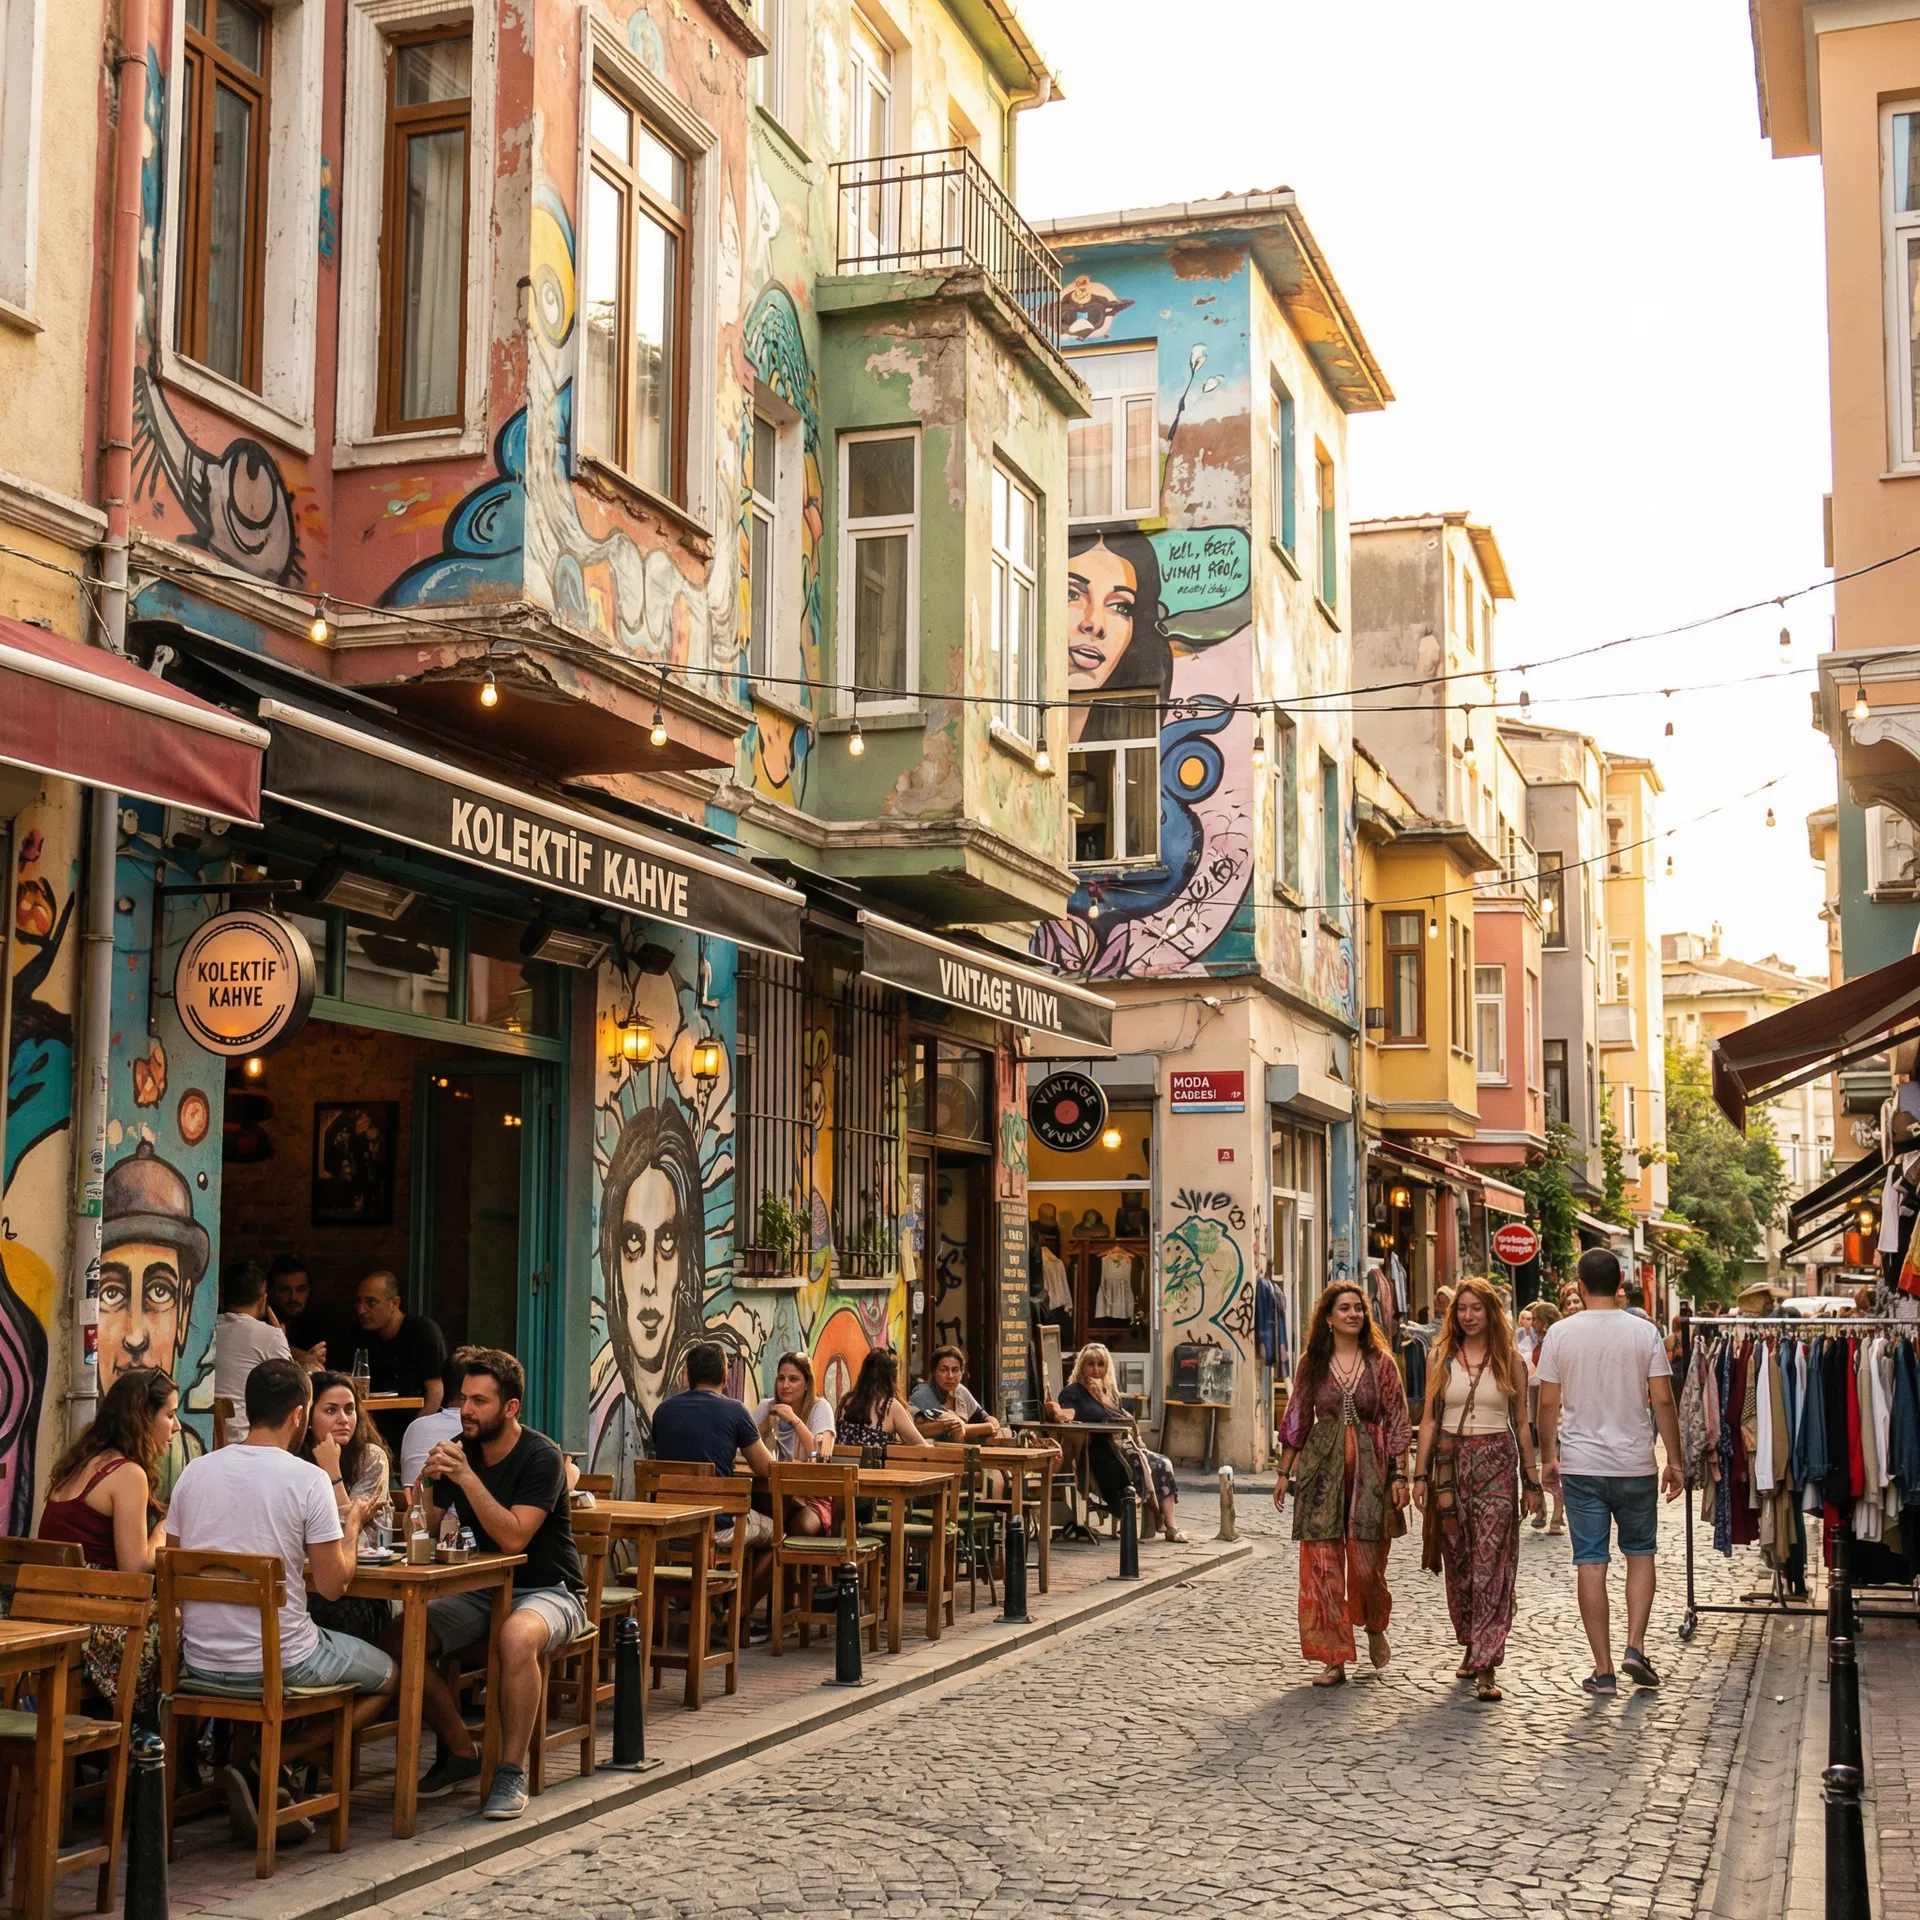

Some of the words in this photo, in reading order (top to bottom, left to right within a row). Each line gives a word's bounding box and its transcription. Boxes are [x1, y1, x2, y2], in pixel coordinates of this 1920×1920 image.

[452, 798, 593, 885] KOLEKTİF
[604, 850, 688, 918] KAHVE
[198, 957, 277, 982] KOLEKTİF
[209, 986, 263, 1007] KAHVE
[939, 957, 1012, 1015] VINTAGE
[1016, 984, 1062, 1031] VINYL
[1036, 1079, 1097, 1107] VINTAGE
[1173, 1076, 1210, 1088] MODA
